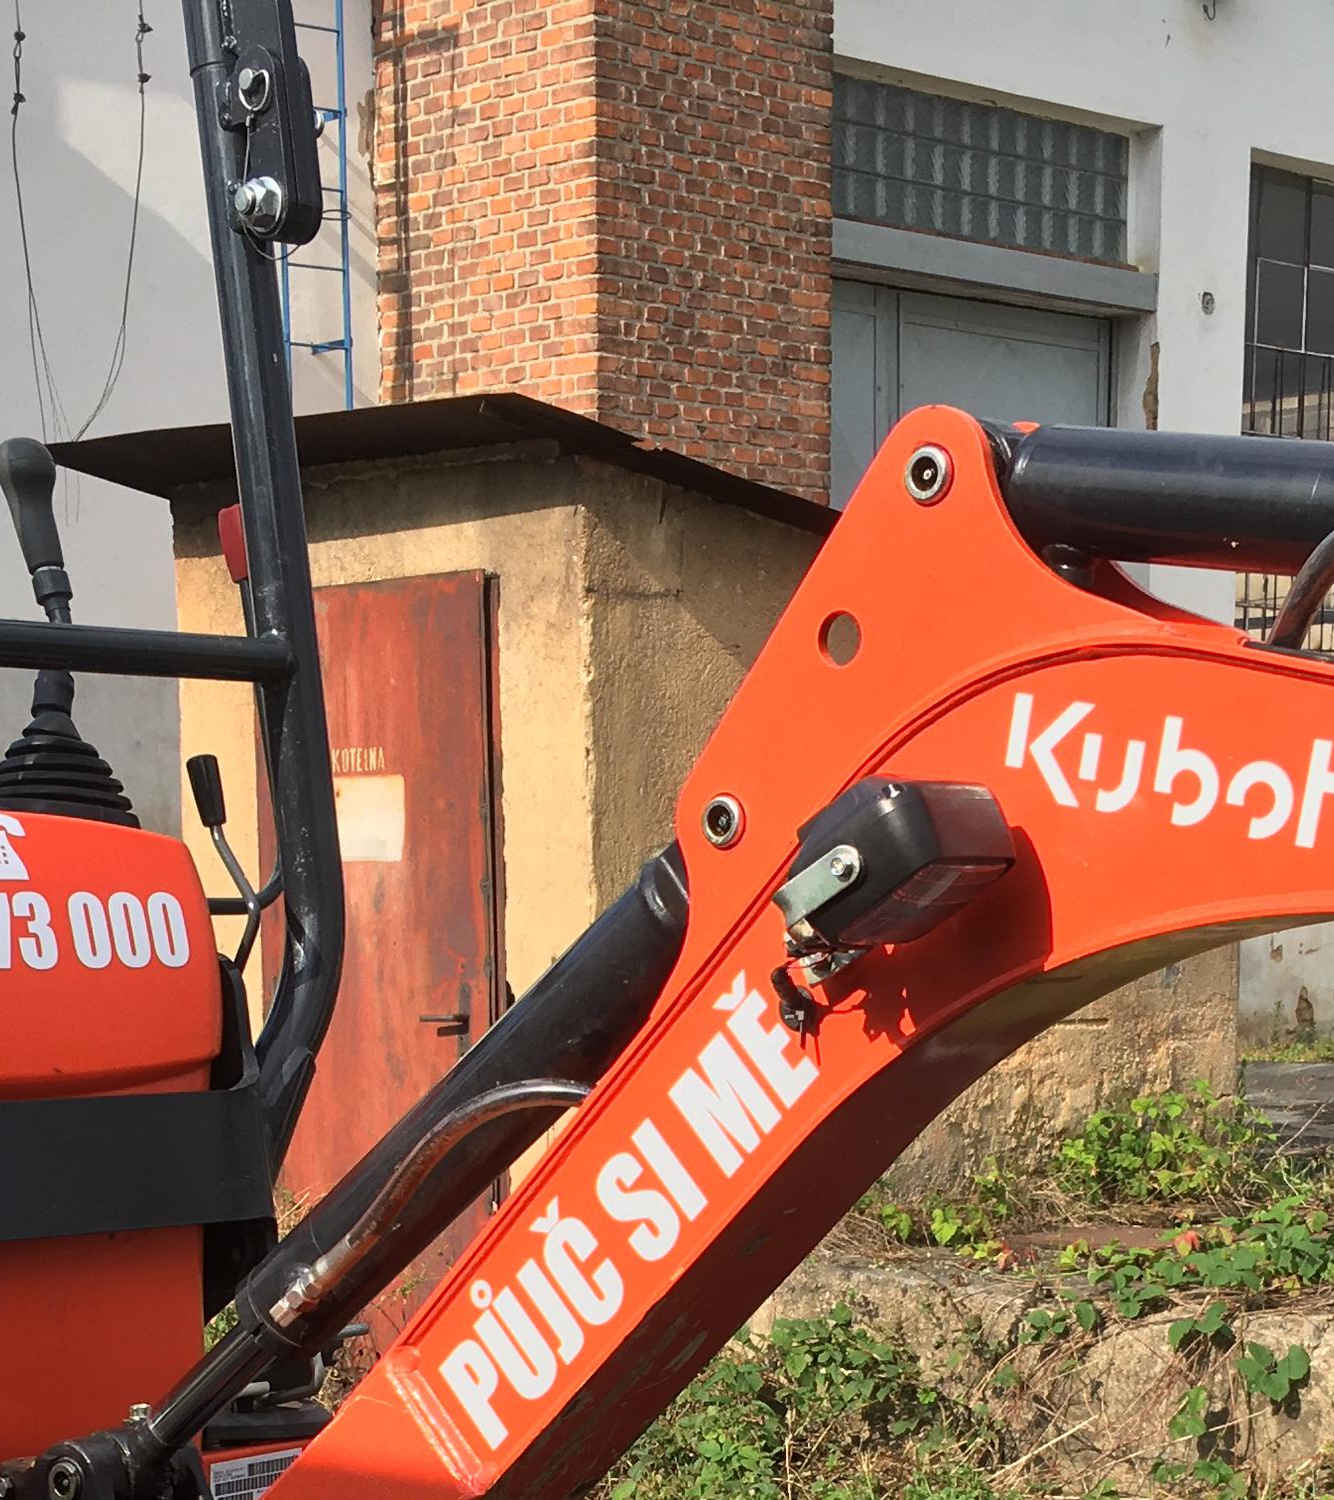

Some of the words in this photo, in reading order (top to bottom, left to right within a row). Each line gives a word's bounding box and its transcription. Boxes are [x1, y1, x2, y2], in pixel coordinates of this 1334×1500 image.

[331, 746, 386, 773] KOTELNA
[67, 890, 190, 970] 000
[438, 1197, 625, 1450] PŮJČ
[596, 1117, 708, 1263] SI
[668, 970, 821, 1178] MĚ
